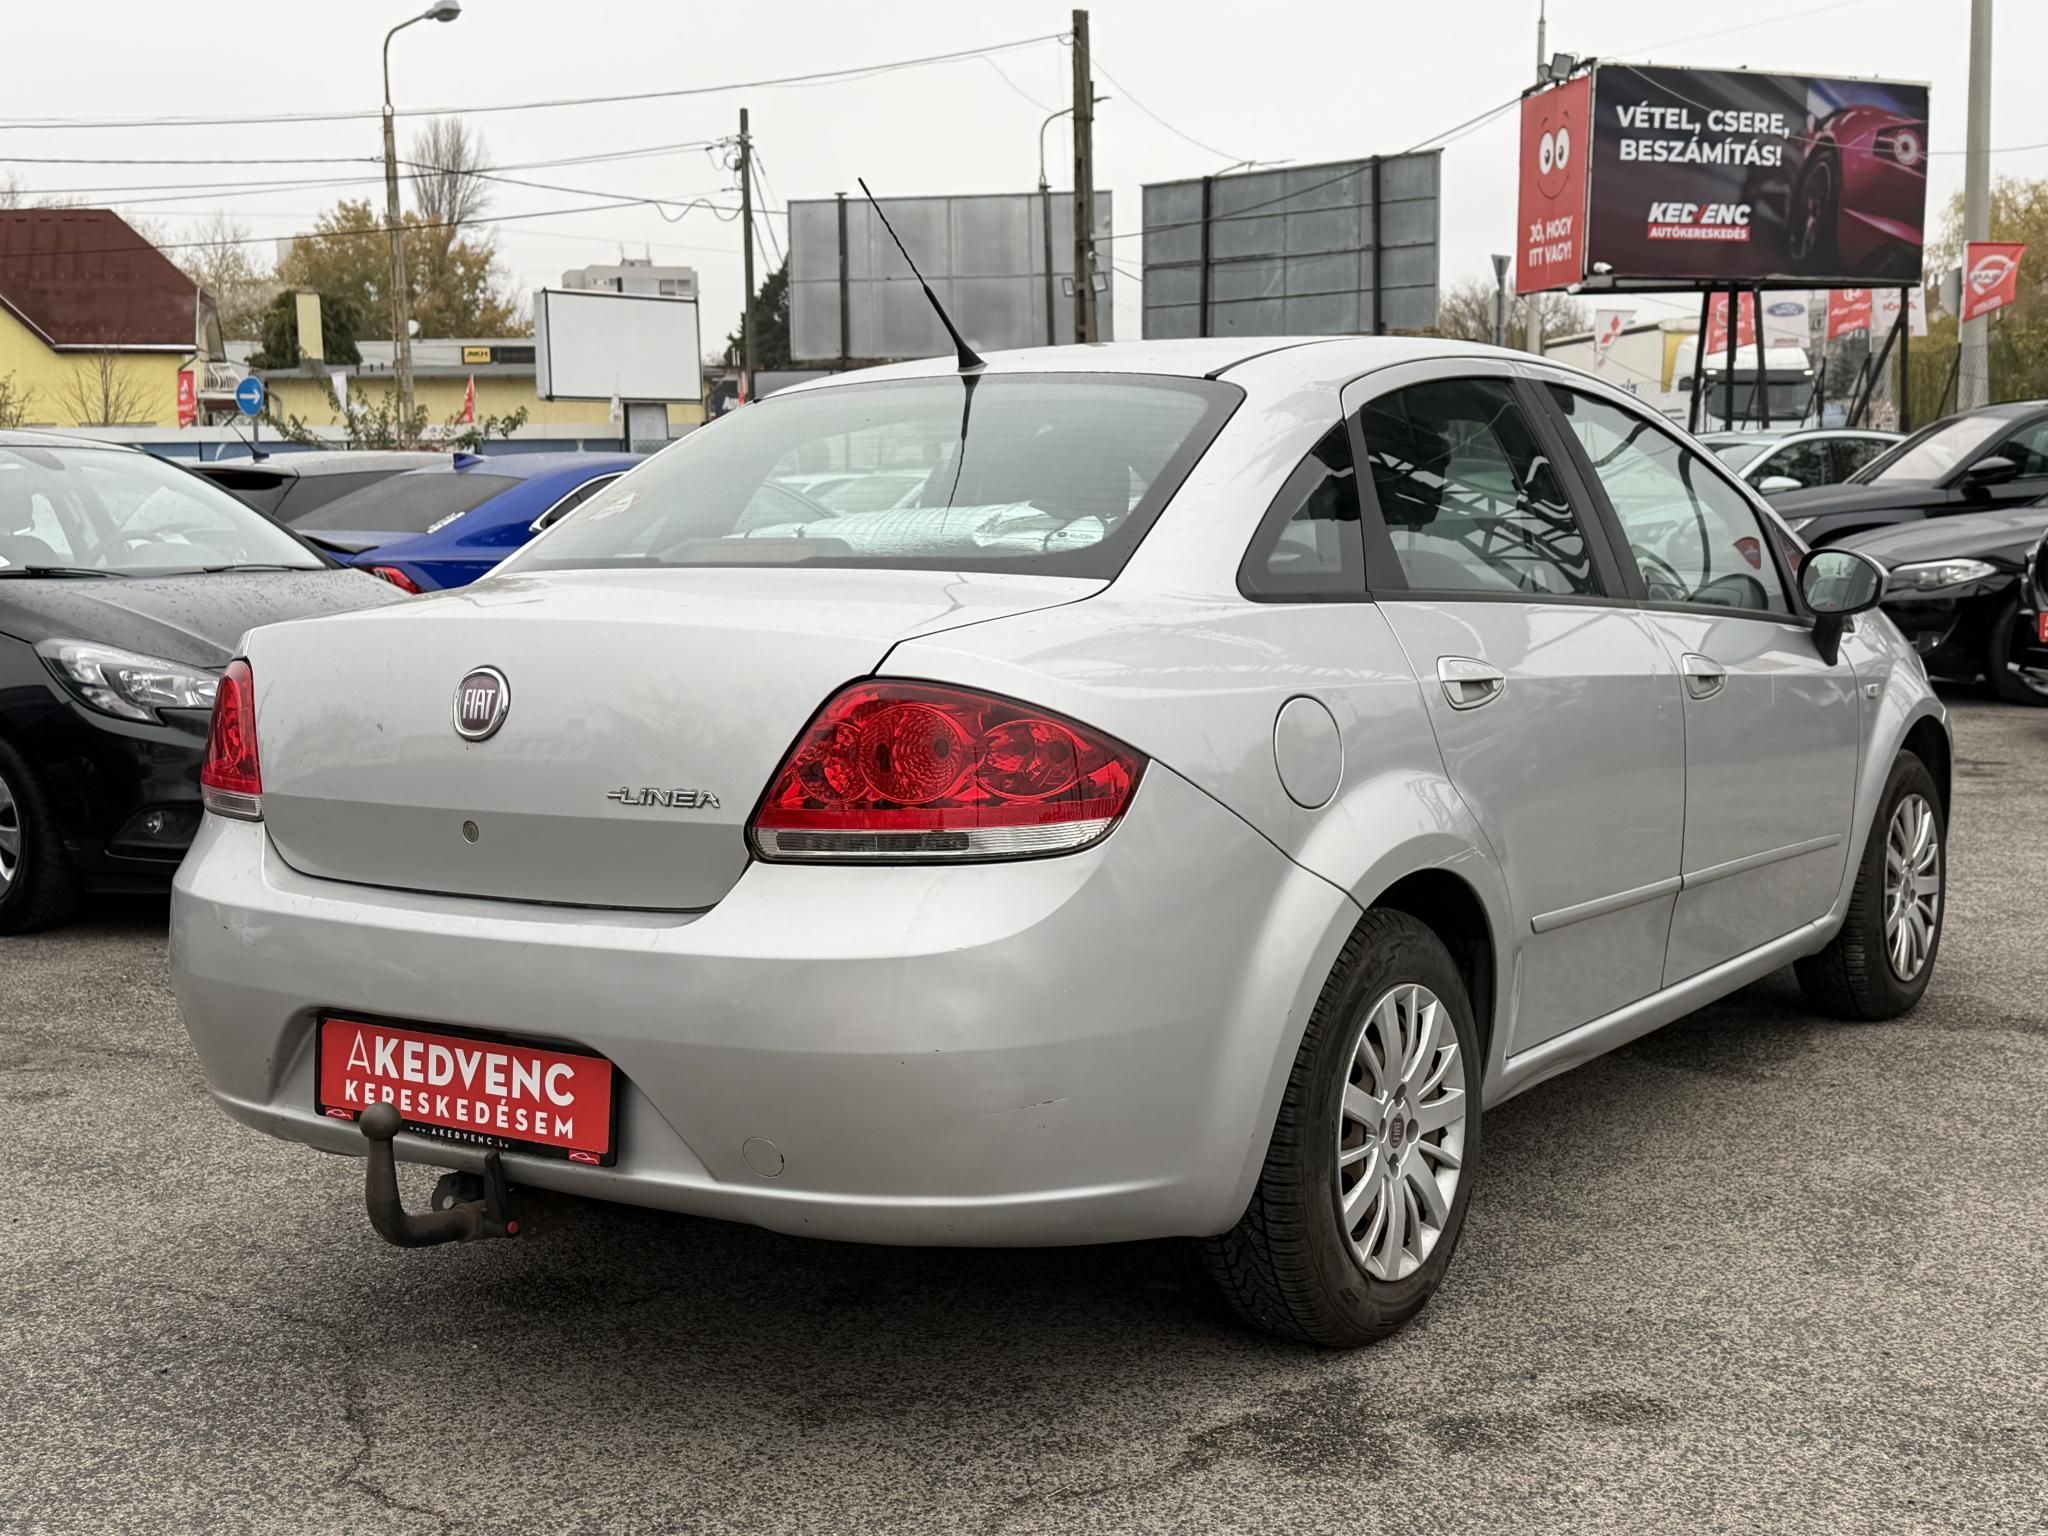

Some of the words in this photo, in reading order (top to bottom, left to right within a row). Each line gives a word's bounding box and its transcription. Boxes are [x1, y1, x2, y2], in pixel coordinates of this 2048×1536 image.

[1616, 100, 1701, 135] VÉTEL,
[1707, 109, 1790, 140] CSERE,
[1619, 136, 1783, 168] BESZÁMÍTÁS!
[1529, 218, 1545, 244] JÓ,
[1546, 215, 1573, 240] HOGY
[1650, 226, 1747, 239] AUTÓKERESKEDÉS
[1528, 247, 1543, 268] ITT
[1545, 240, 1573, 264] VAGY!
[463, 689, 496, 720] FIAT
[606, 786, 721, 809] LINEA
[345, 1079, 574, 1140] KERESKEDÉSEM
